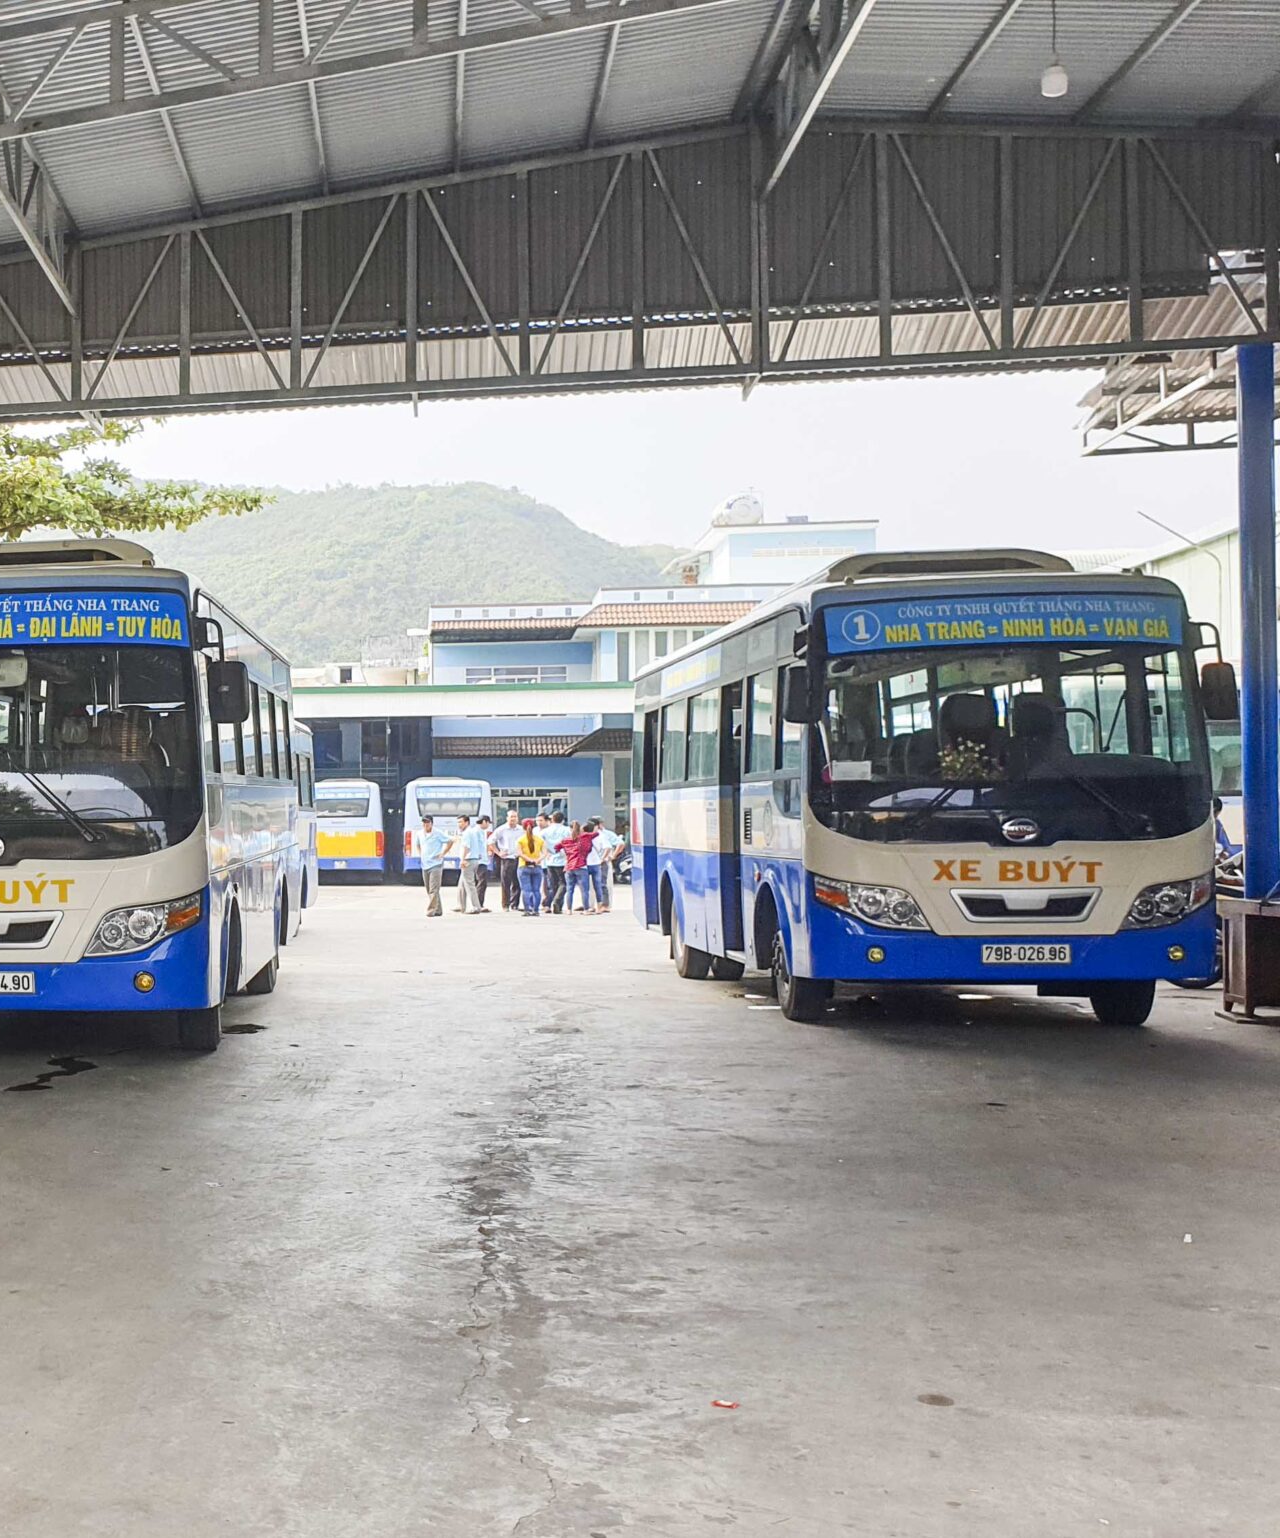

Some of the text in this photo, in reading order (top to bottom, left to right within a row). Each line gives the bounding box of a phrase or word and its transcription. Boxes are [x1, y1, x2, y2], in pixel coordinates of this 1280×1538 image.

[24, 593, 73, 613] THẮNG
[77, 600, 107, 611] NHA
[111, 599, 160, 612] TRANG
[898, 596, 1155, 618] CÔNG TY TNHH QUYẾT THẮNG NHA TRANG
[30, 616, 56, 642] ĐẠI
[61, 612, 102, 637] LÃNH
[117, 615, 146, 637] TUY
[151, 613, 182, 640] HÒA
[853, 615, 870, 640] 1
[885, 623, 921, 643] NHA
[925, 619, 985, 640] TRANG
[1002, 618, 1045, 638] NINH
[1050, 613, 1087, 638] HÒA
[1103, 617, 1138, 640] VẠN
[1143, 615, 1169, 638] GIÃ
[933, 855, 1103, 883] XE BUÝT
